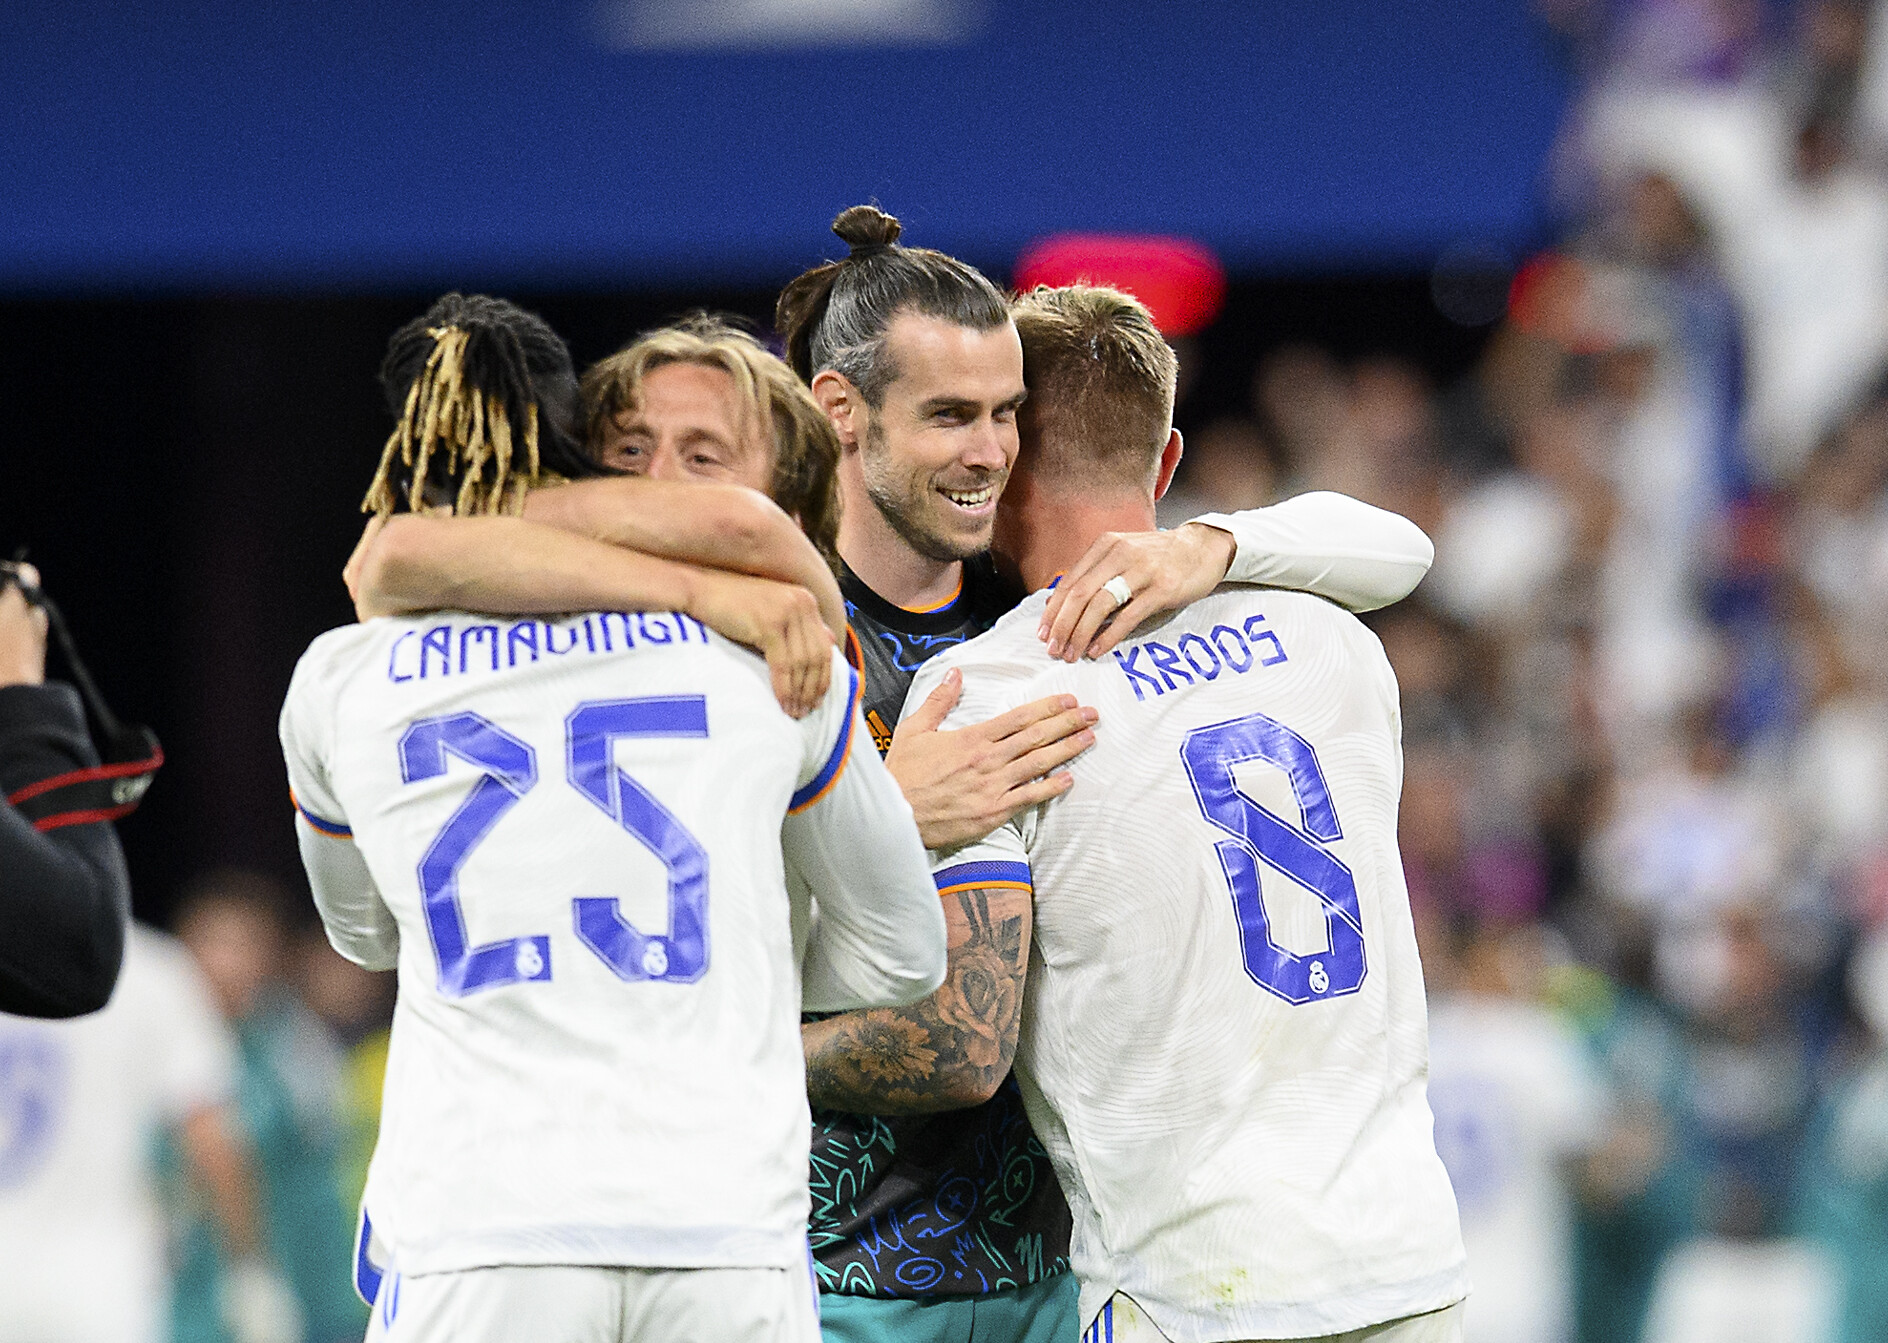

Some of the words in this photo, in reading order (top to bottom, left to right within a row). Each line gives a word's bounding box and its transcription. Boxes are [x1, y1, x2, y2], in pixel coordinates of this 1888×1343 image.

[1114, 614, 1288, 701] KROOS
[398, 695, 710, 997] 25
[1180, 713, 1368, 1006] 8
